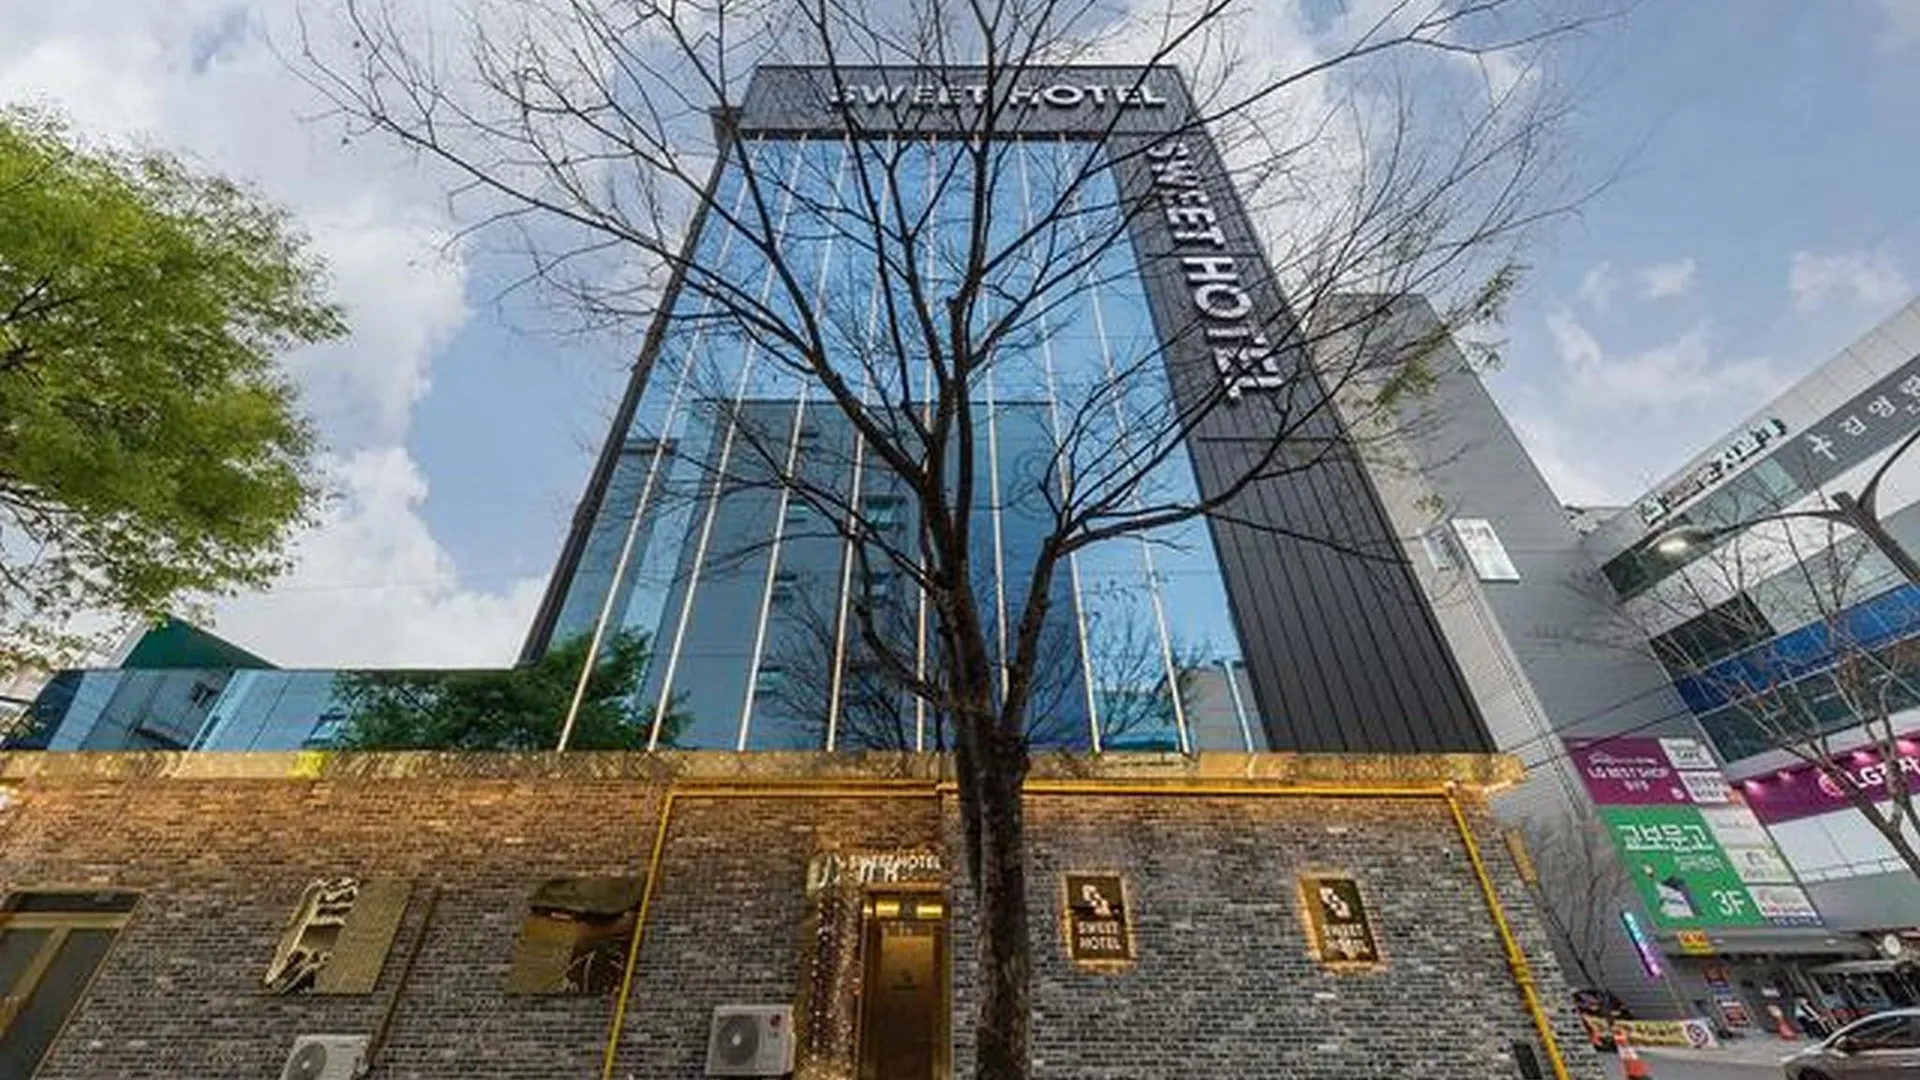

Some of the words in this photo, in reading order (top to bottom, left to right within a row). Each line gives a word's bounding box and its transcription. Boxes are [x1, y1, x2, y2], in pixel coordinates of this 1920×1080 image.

[830, 84, 990, 105] SWEET
[1010, 84, 1166, 107] HOTEL
[1147, 142, 1225, 250] SWEET
[1182, 257, 1284, 398] HOTEL
[1616, 824, 1716, 853] 교보문고
[1711, 890, 1746, 915] 3F
[1078, 921, 1119, 934] SWEET
[1079, 936, 1122, 950] HOTEL
